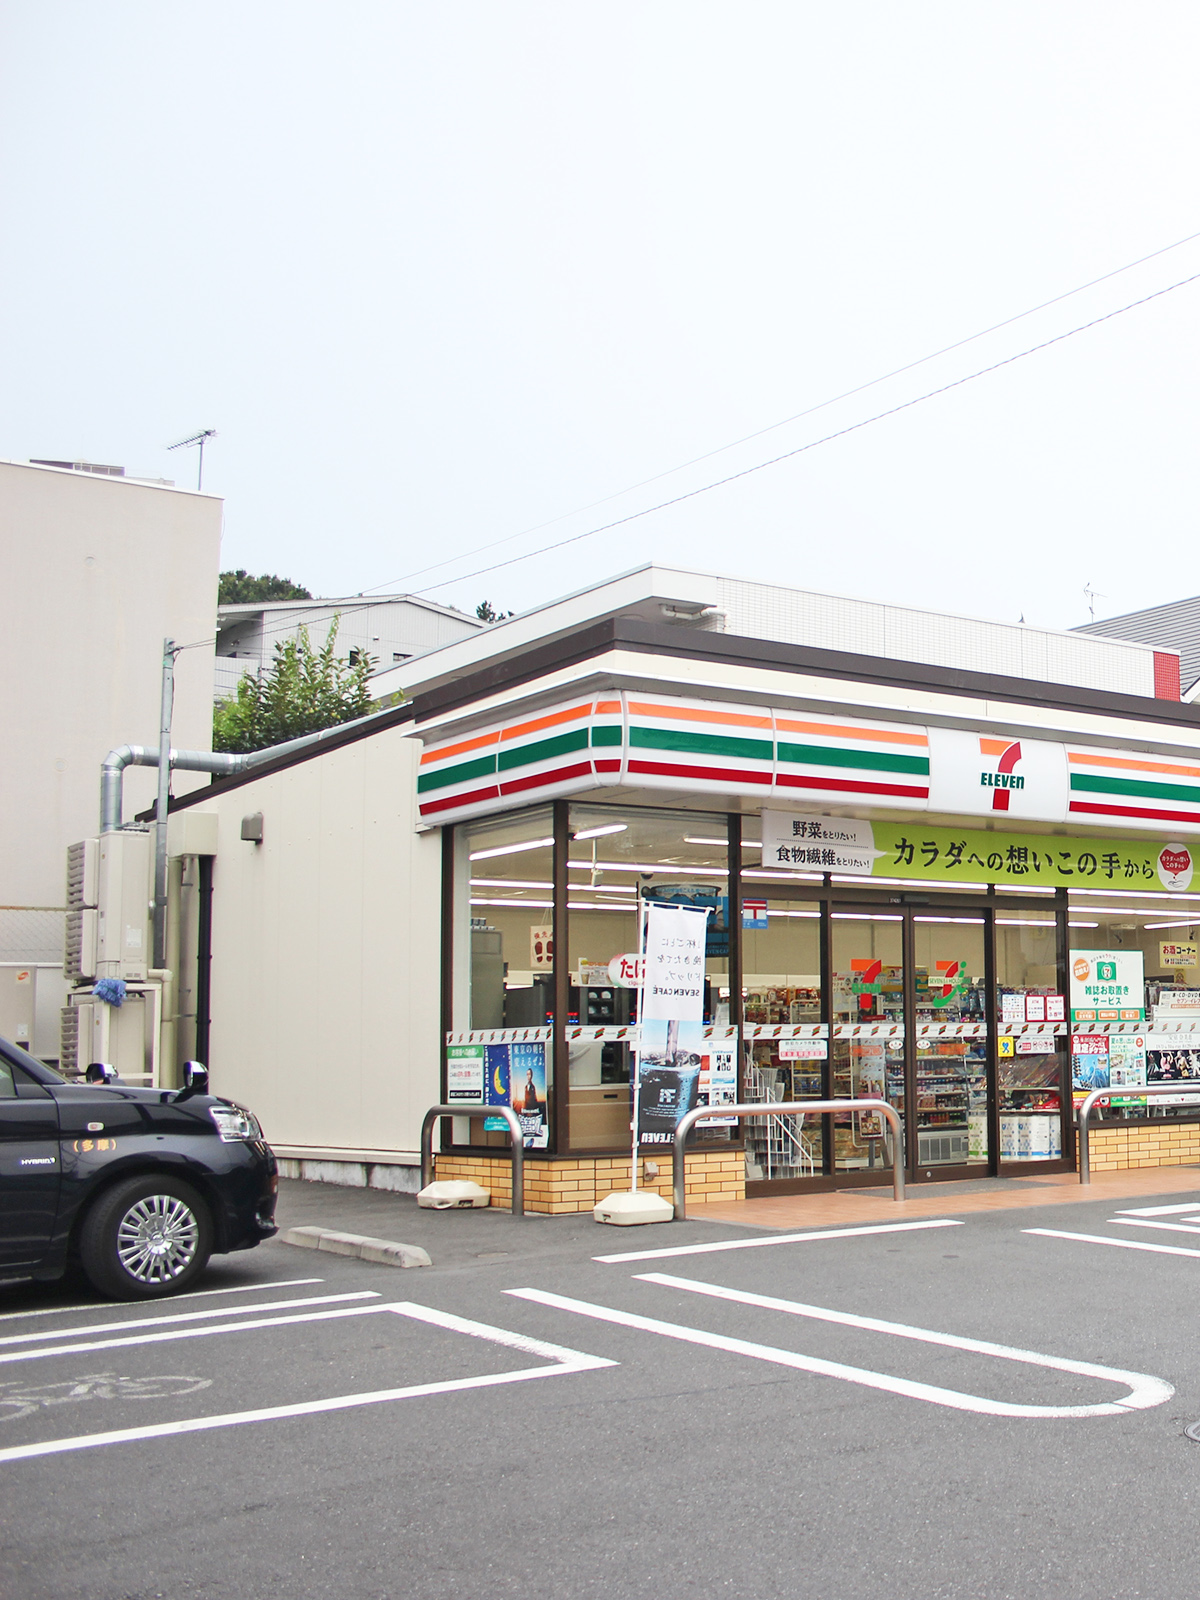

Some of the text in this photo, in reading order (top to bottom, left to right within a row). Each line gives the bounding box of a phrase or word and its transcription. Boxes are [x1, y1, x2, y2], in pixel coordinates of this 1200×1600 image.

[980, 772, 1025, 790] ELEVEN
[791, 820, 857, 842] 野菜をとりたい!
[775, 844, 870, 869] 食物繊維をとりたい!
[893, 837, 1155, 880] カラダへの想いこの手から
[1163, 945, 1196, 955] お酒コーナー
[1085, 985, 1130, 996] 雑誌お取置き
[1092, 997, 1122, 1006] サービス
